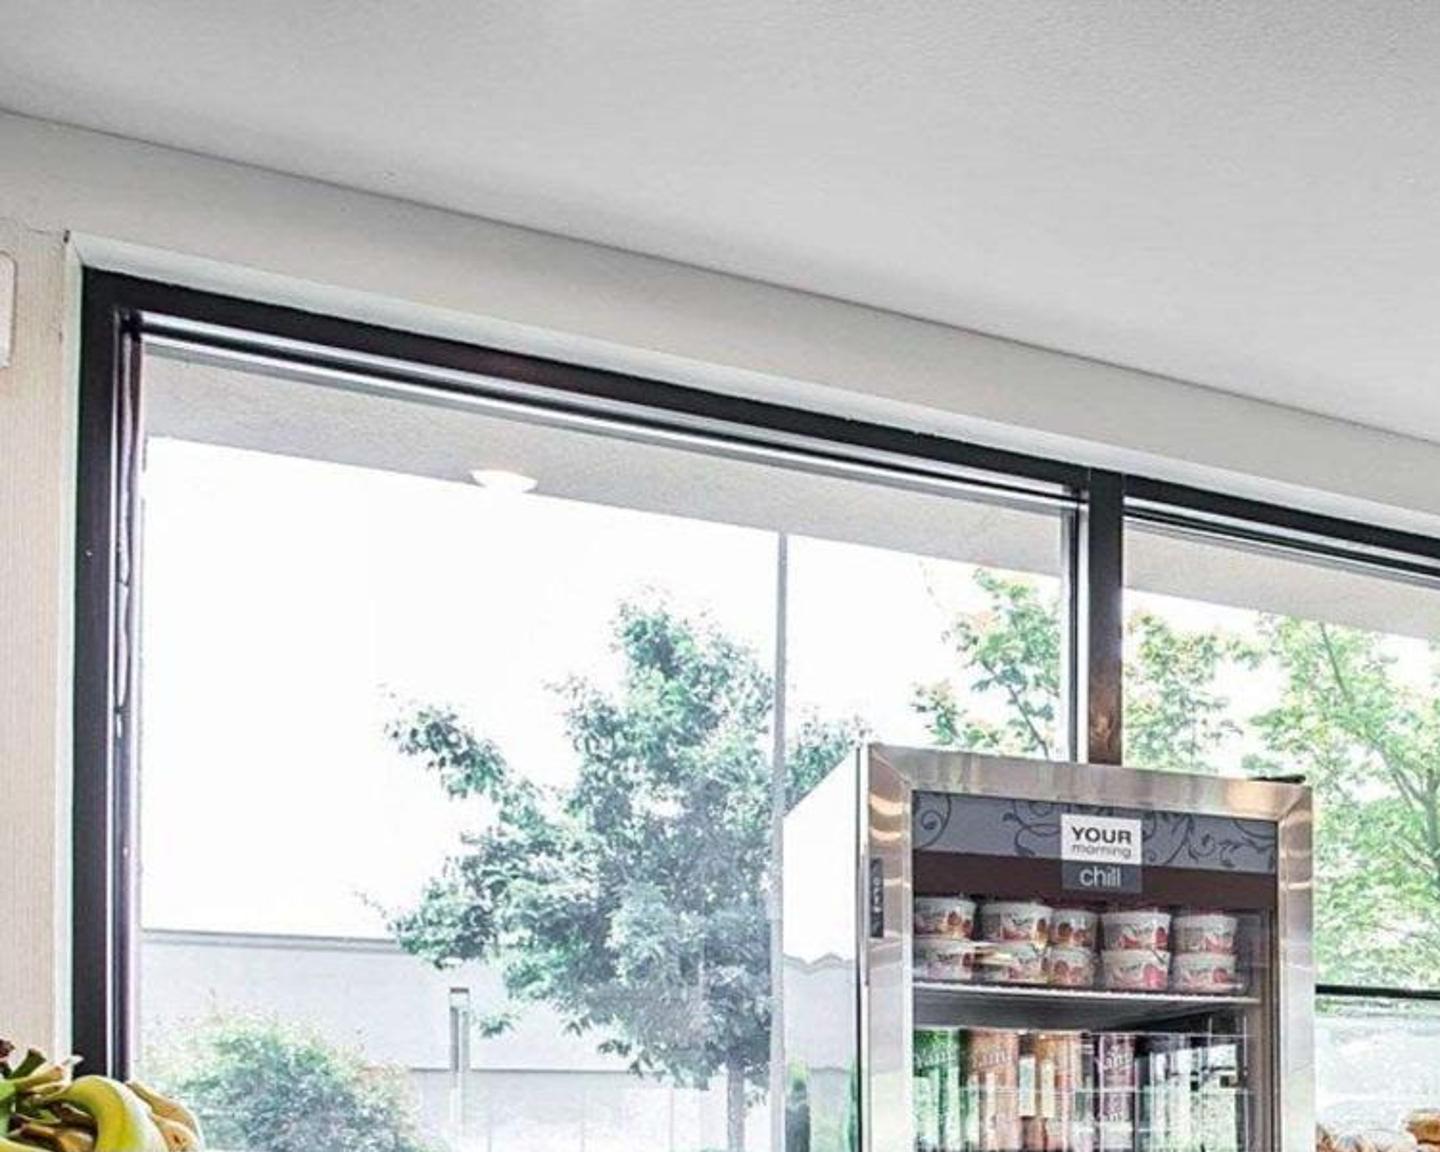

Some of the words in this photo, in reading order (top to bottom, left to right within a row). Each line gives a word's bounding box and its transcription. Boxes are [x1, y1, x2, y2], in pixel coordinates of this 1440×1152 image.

[1071, 826, 1132, 845] YOUR
[1072, 844, 1132, 859] morning
[1080, 865, 1121, 887] chill
